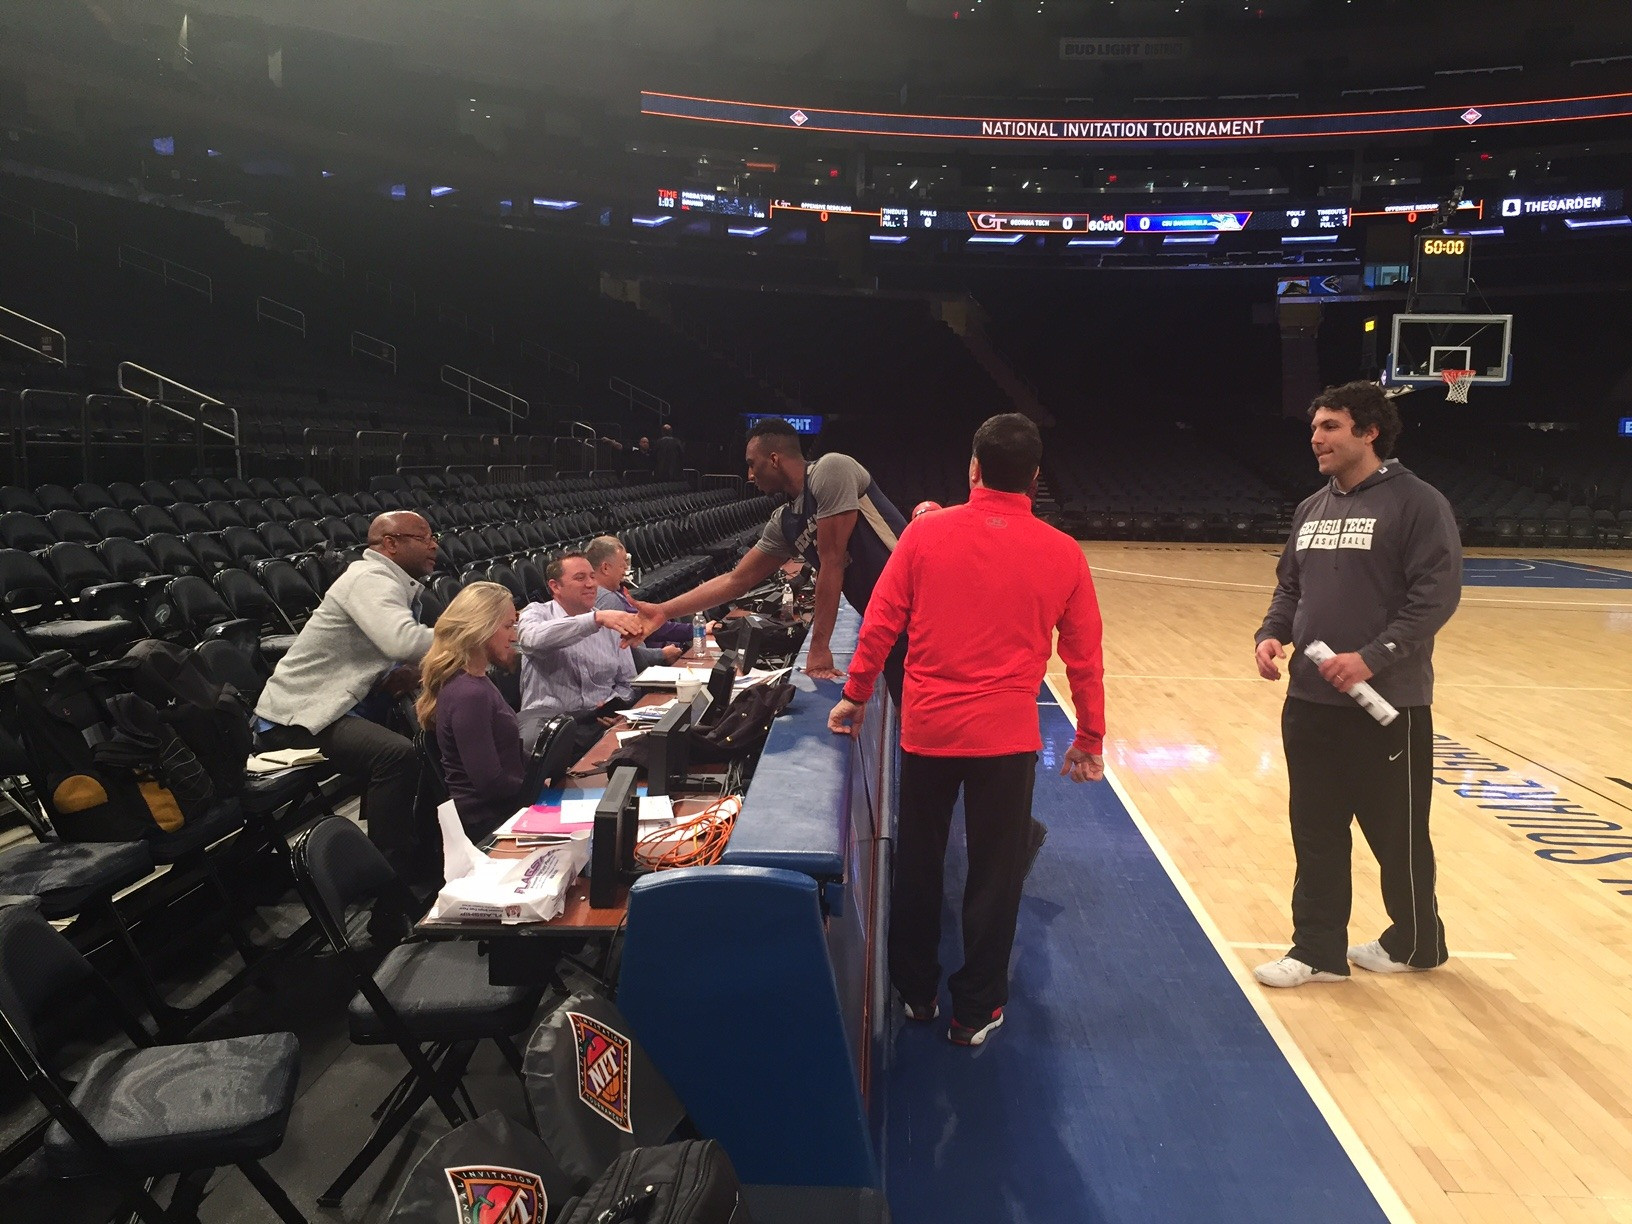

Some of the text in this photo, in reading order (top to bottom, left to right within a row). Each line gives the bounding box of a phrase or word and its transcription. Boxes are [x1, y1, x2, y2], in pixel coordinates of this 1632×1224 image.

[1065, 43, 1096, 55] BUD
[1097, 43, 1140, 55] LIGHT
[982, 120, 1264, 137] NATIONAL INVITATION TOURNAMENT
[659, 189, 678, 199] TIME
[658, 197, 675, 208] 1:03
[800, 202, 826, 211] OFFENSIVE
[1415, 203, 1439, 211] REBOUN
[1524, 197, 1602, 213] THEGARDEN
[820, 211, 829, 222] 0
[882, 208, 908, 216] TIMEOUTS
[1317, 208, 1346, 216] TIMEOUTS
[1407, 212, 1417, 223] 0
[924, 217, 932, 228] 0
[977, 213, 1007, 230] GT
[1010, 219, 1050, 227] GEORGIA TECH
[1062, 217, 1073, 230] 0
[1088, 220, 1124, 232] 60:00
[1139, 217, 1150, 231] 0
[1291, 217, 1299, 228] 0
[1424, 240, 1465, 255] 60:00
[1342, 518, 1377, 534] TECH
[1313, 537, 1366, 546] ASKEBALL
[514, 849, 561, 895] FLAGS
[587, 1045, 621, 1099] NIT
[461, 1171, 533, 1185] INVITATION
[457, 1182, 472, 1224] ONAL
